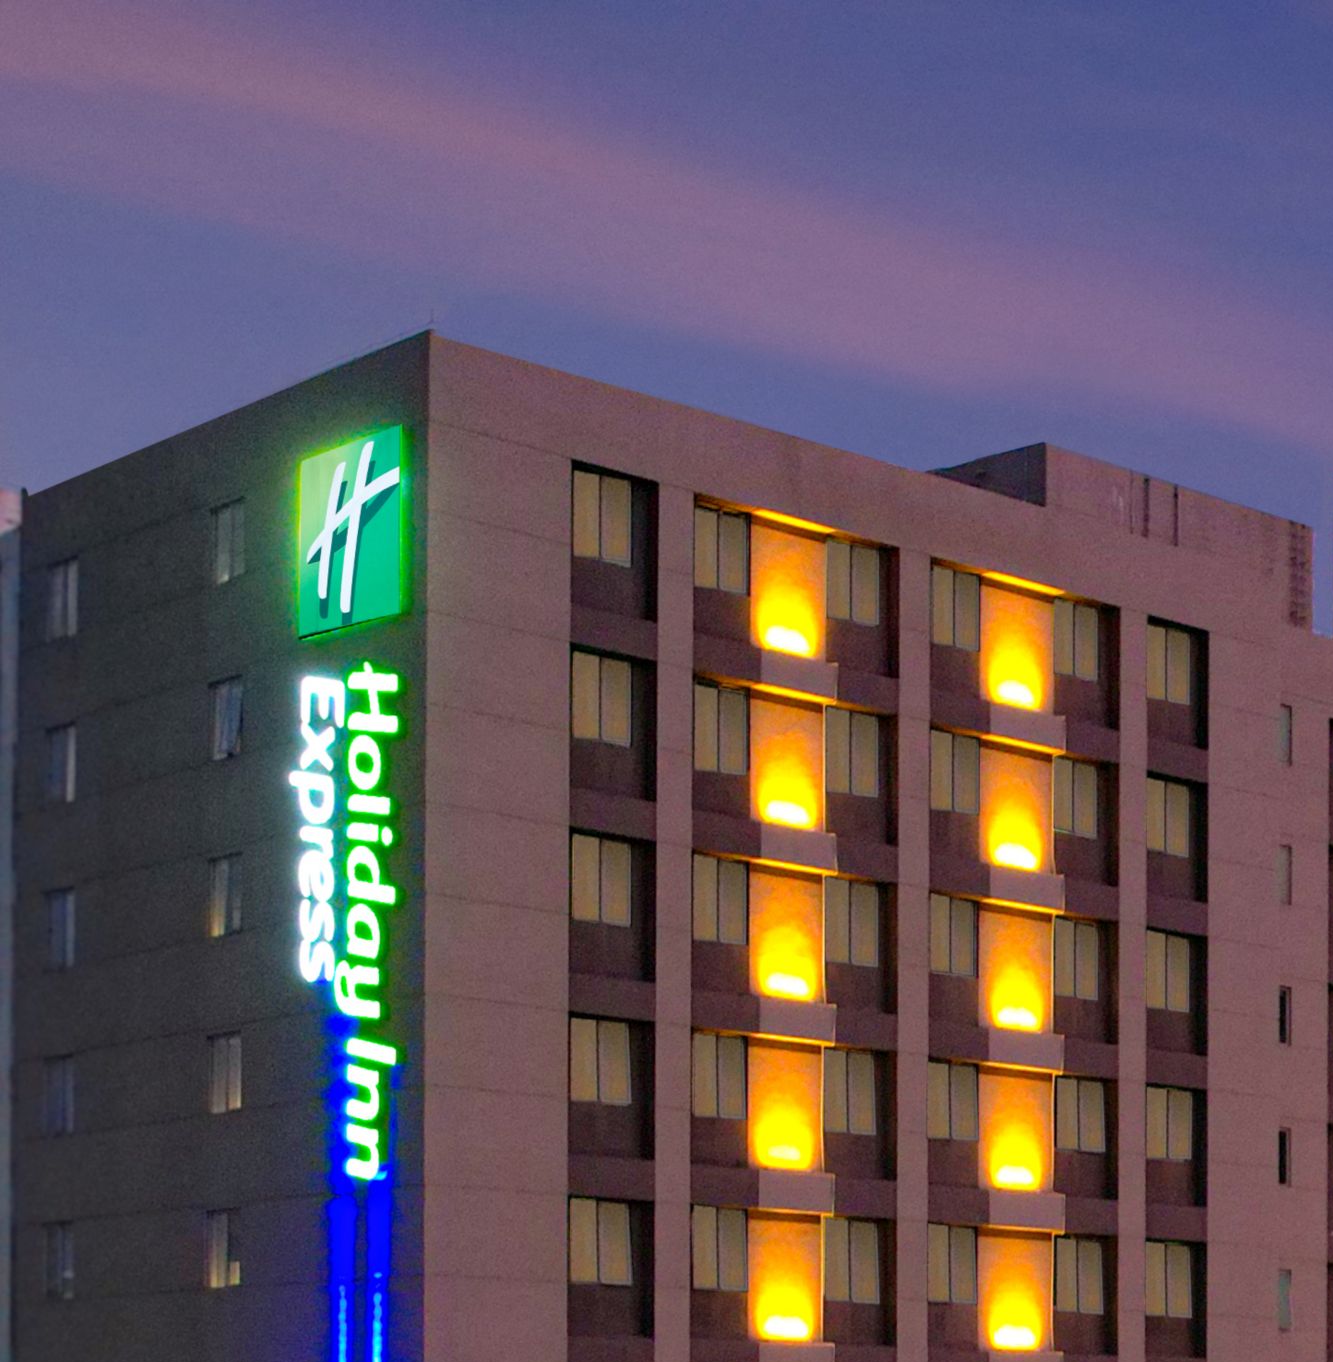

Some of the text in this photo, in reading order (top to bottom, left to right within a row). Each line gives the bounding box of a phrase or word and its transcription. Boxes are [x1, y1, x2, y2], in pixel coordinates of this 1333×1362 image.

[286, 674, 346, 983] Express
[334, 661, 399, 1180] Holiday Inn
